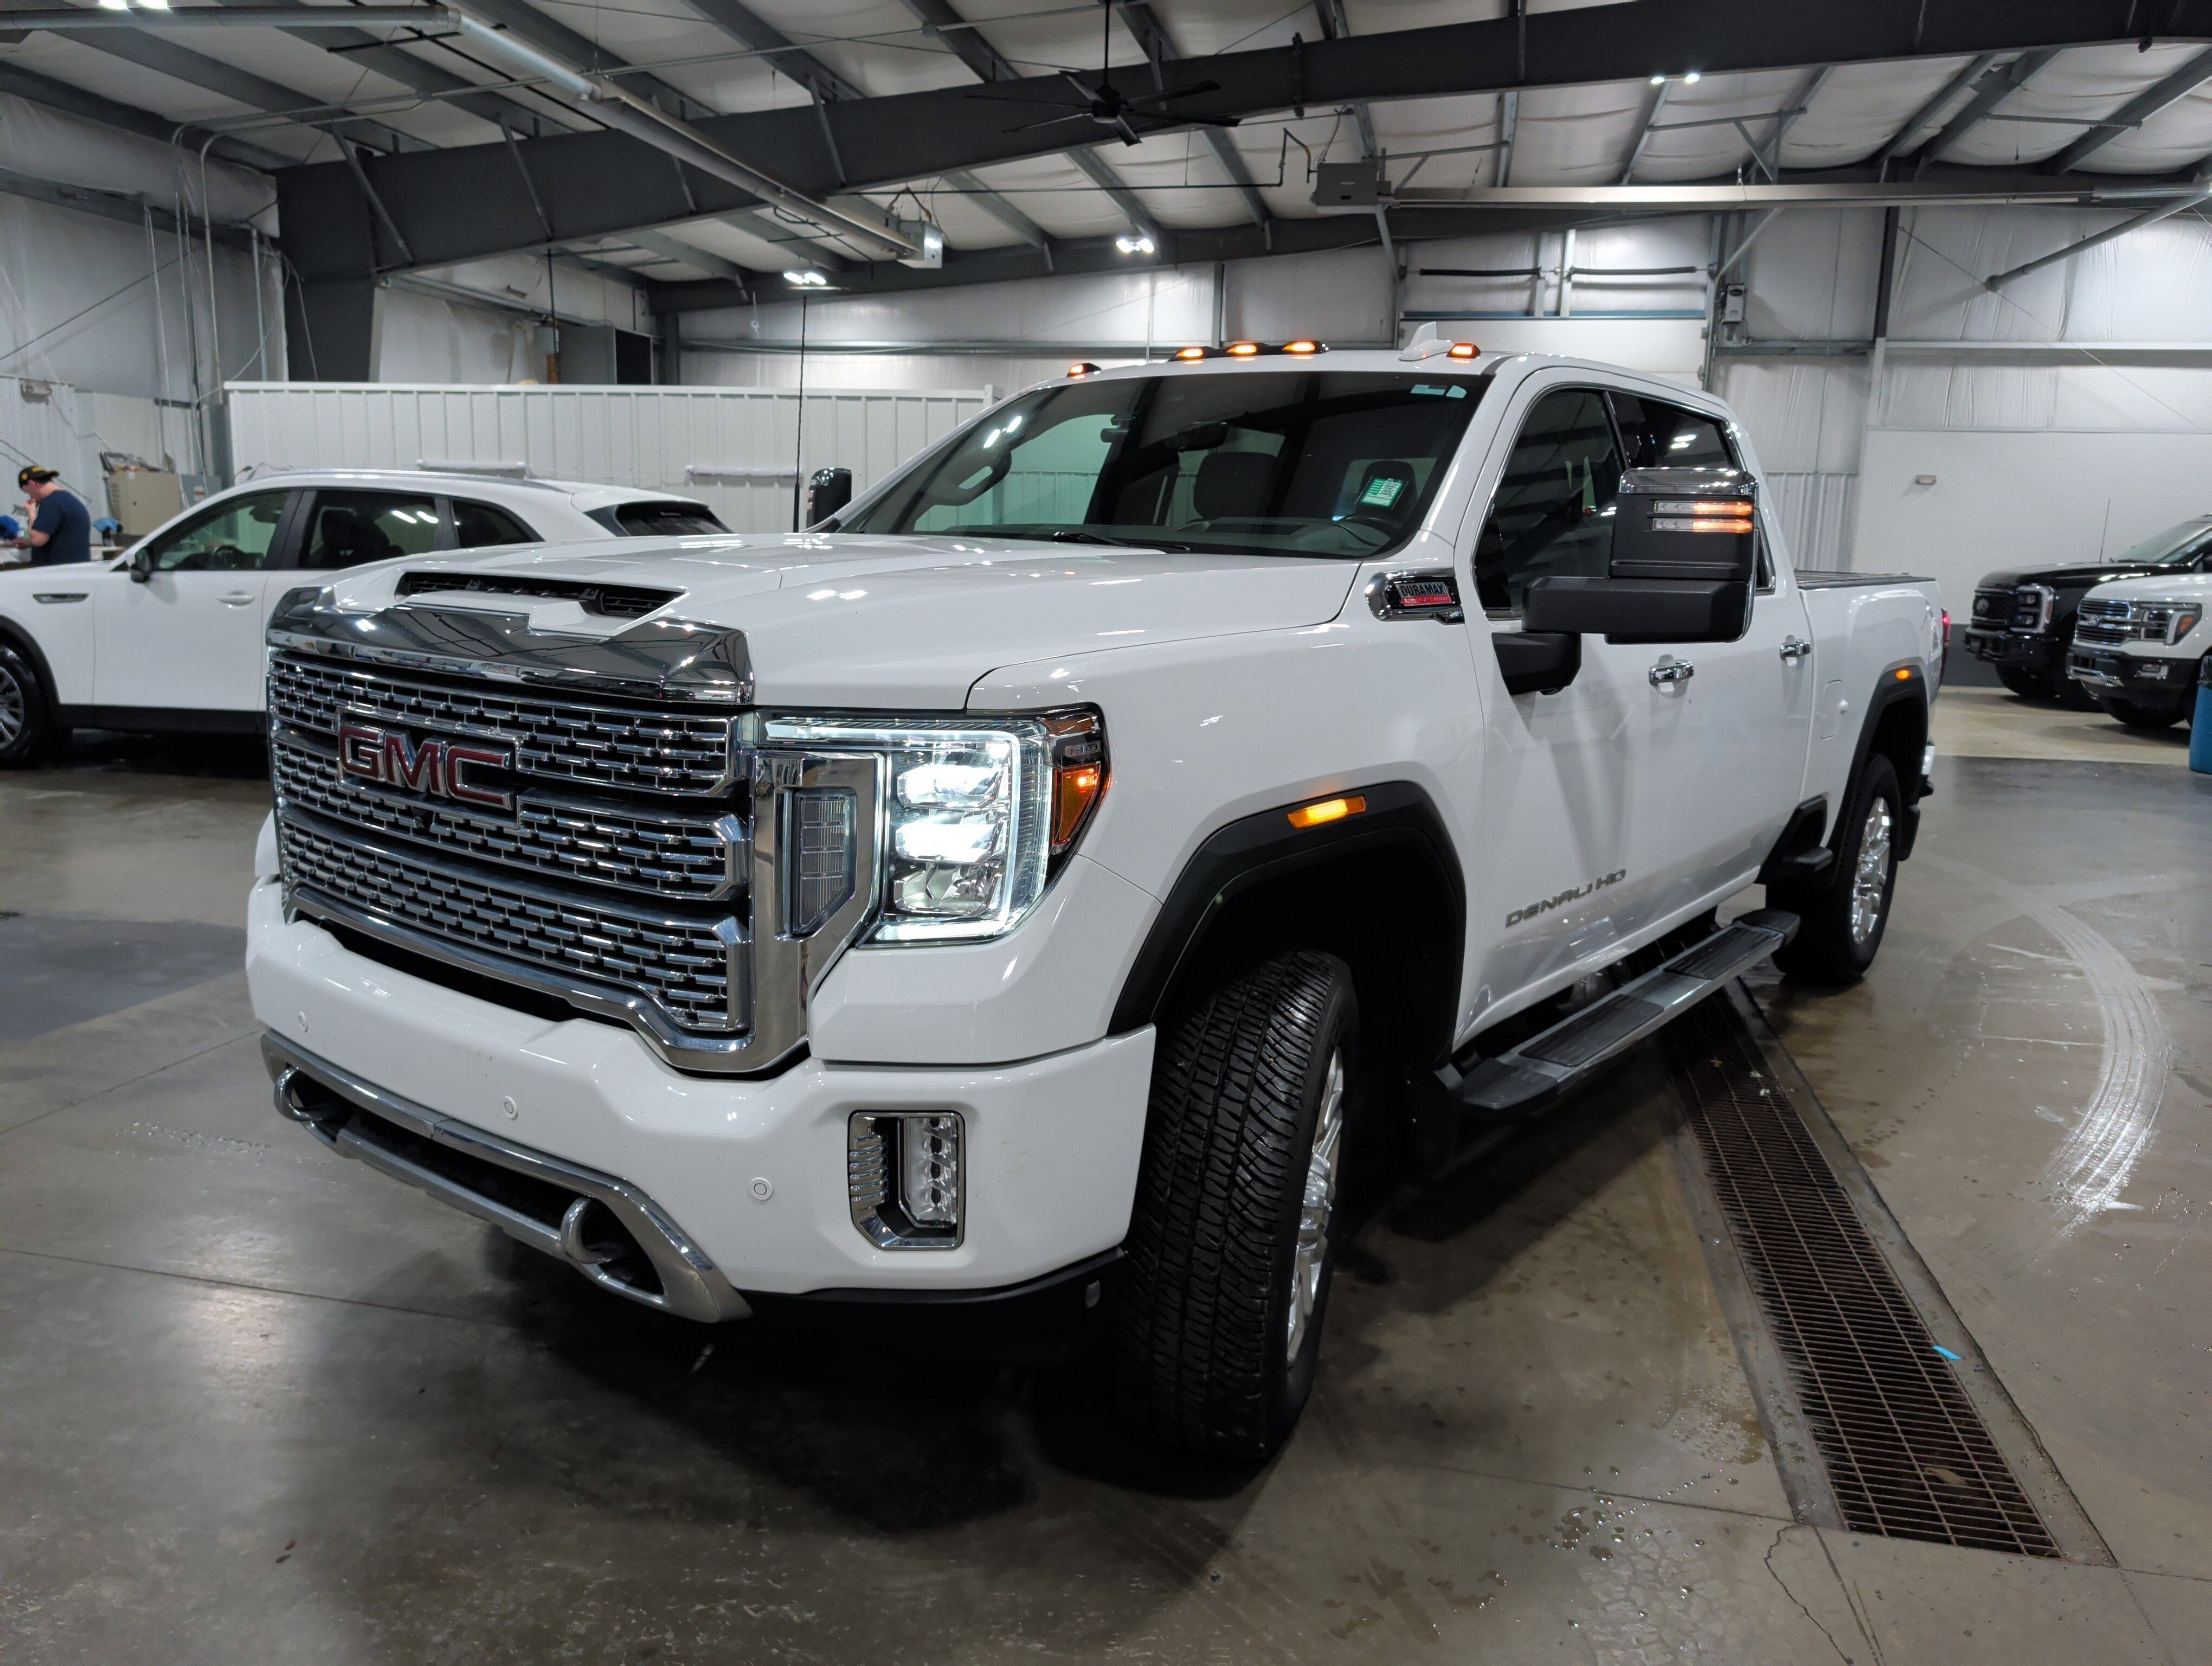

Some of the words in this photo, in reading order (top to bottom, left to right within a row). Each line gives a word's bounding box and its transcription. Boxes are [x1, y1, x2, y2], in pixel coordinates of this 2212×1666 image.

[1400, 584, 1445, 596] DURAMAX
[338, 725, 513, 810] GMC
[1505, 882, 1592, 928] DENALI
[1596, 869, 1625, 889] HD
